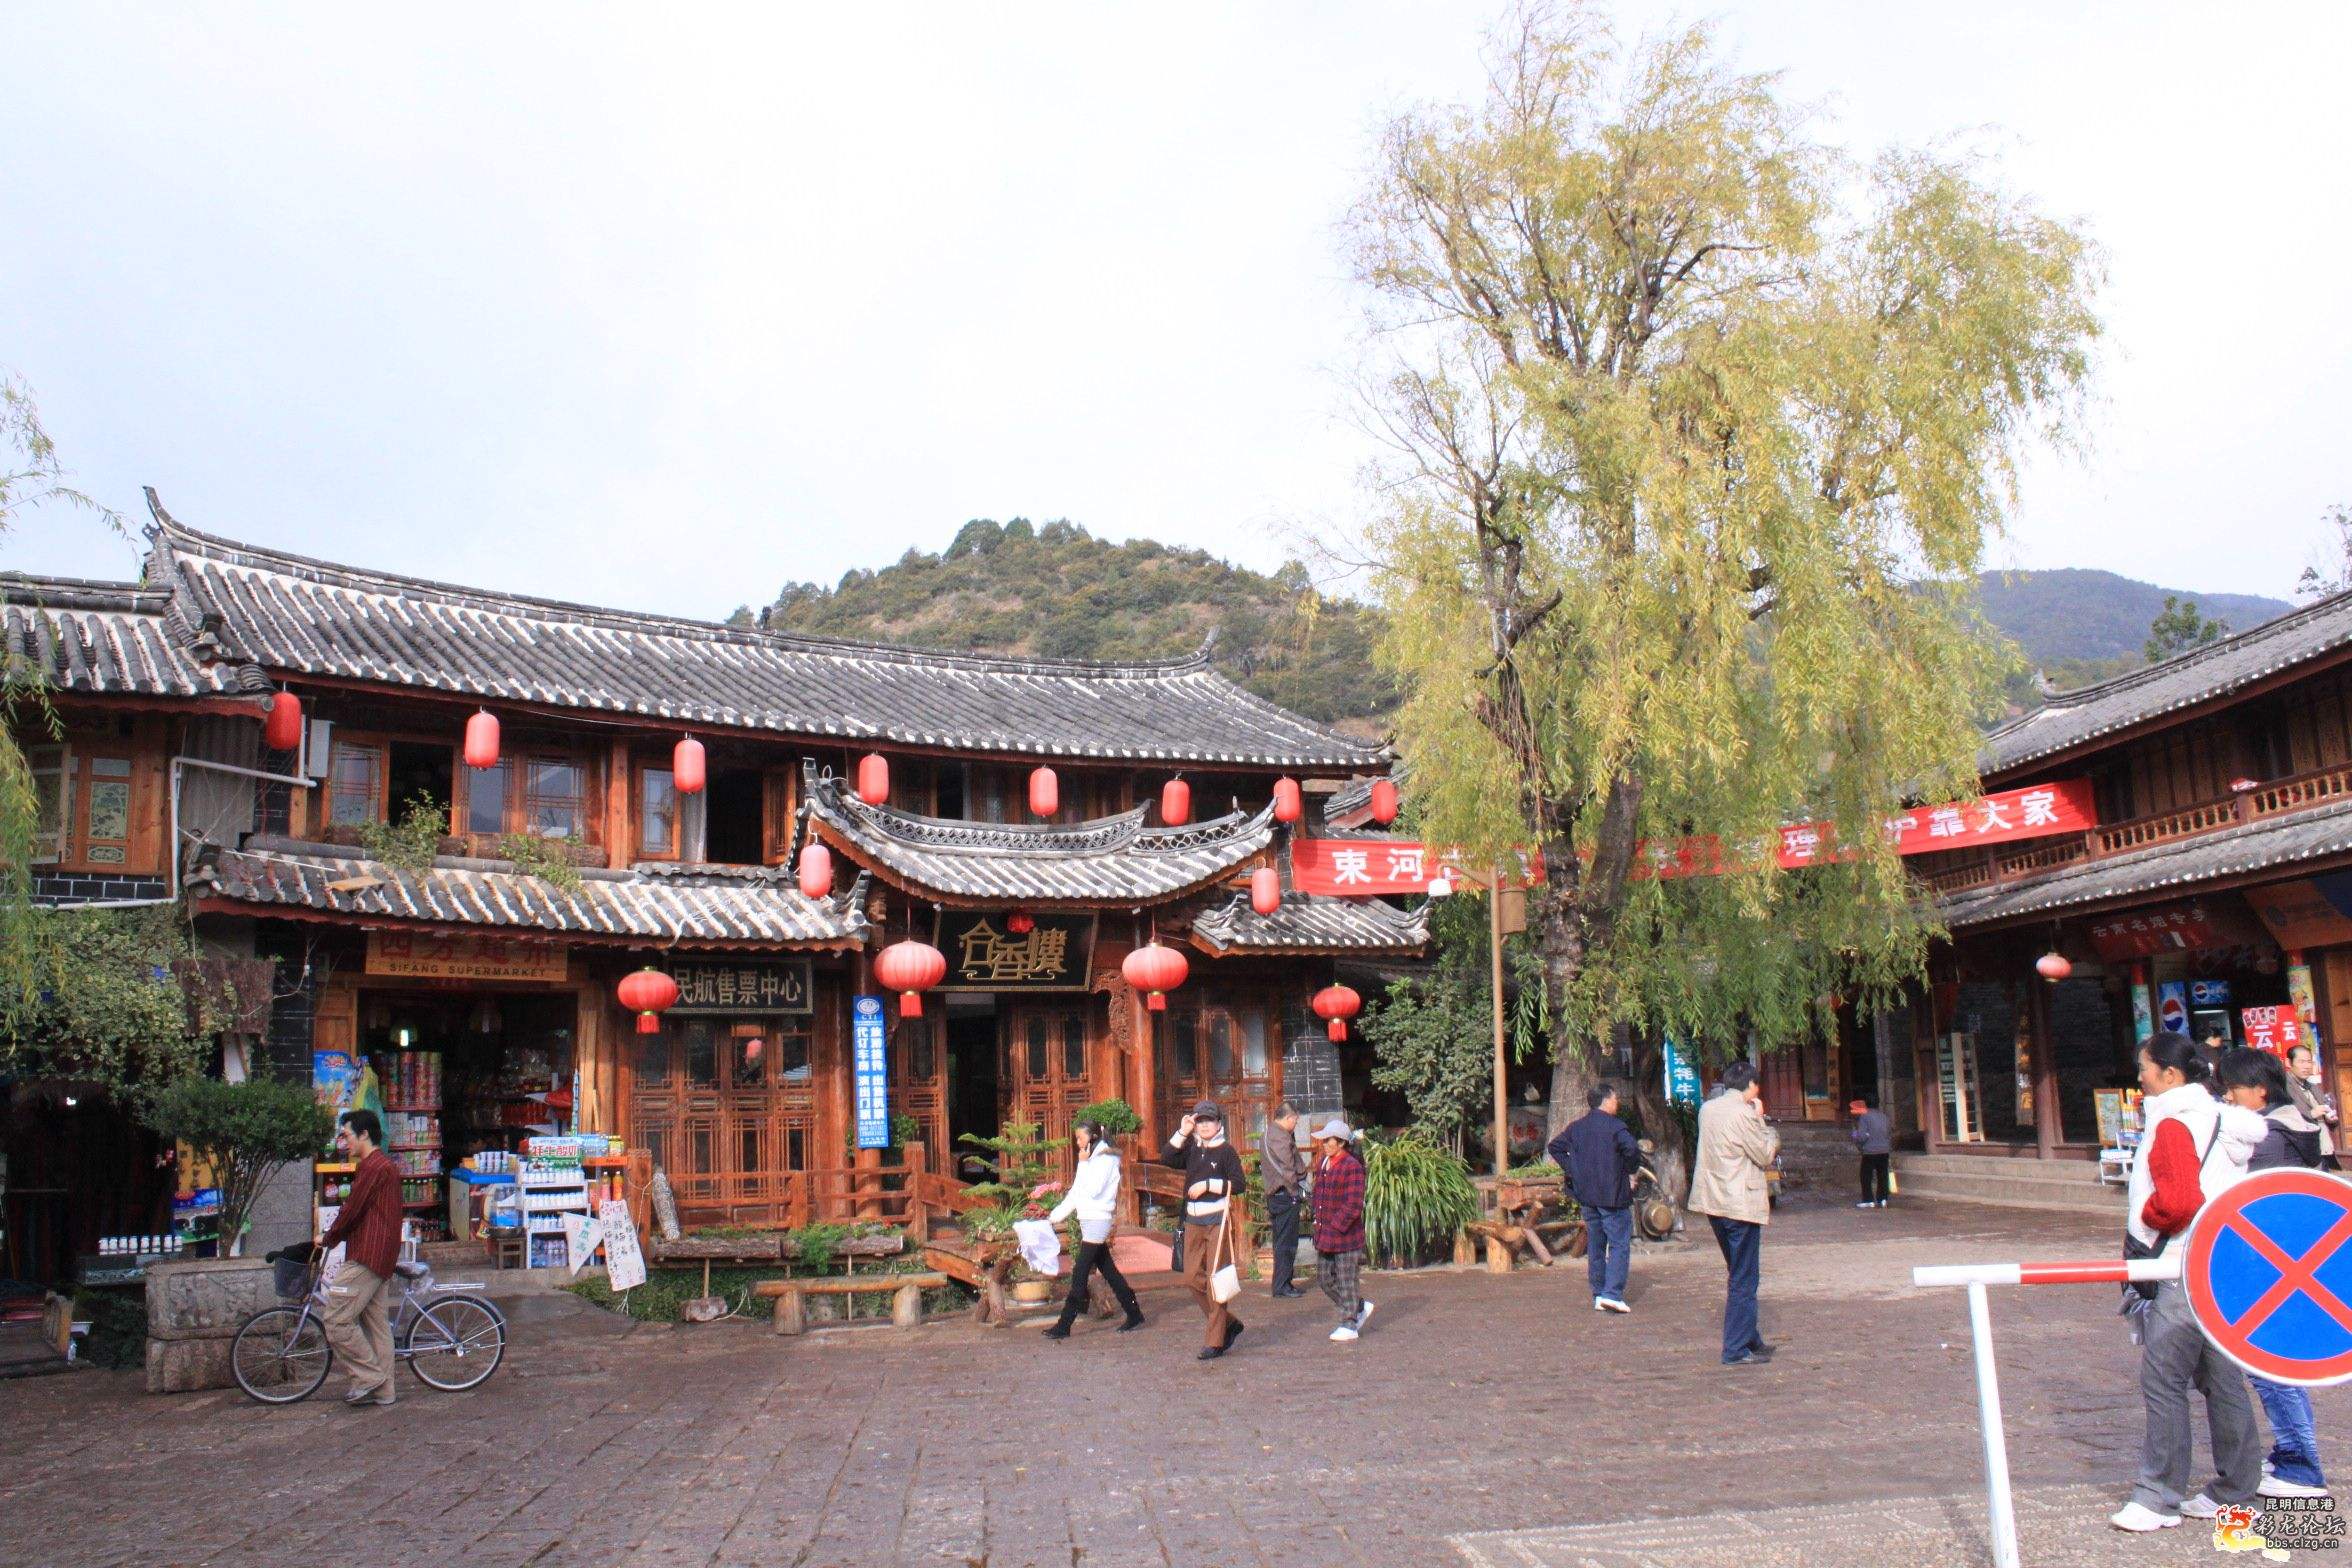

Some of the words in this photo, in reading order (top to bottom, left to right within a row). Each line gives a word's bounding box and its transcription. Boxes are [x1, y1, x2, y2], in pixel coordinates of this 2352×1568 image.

[389, 963, 439, 973] SIFANG
[448, 966, 546, 977] SUPERMARKET
[673, 967, 802, 1005] 民航售票中心
